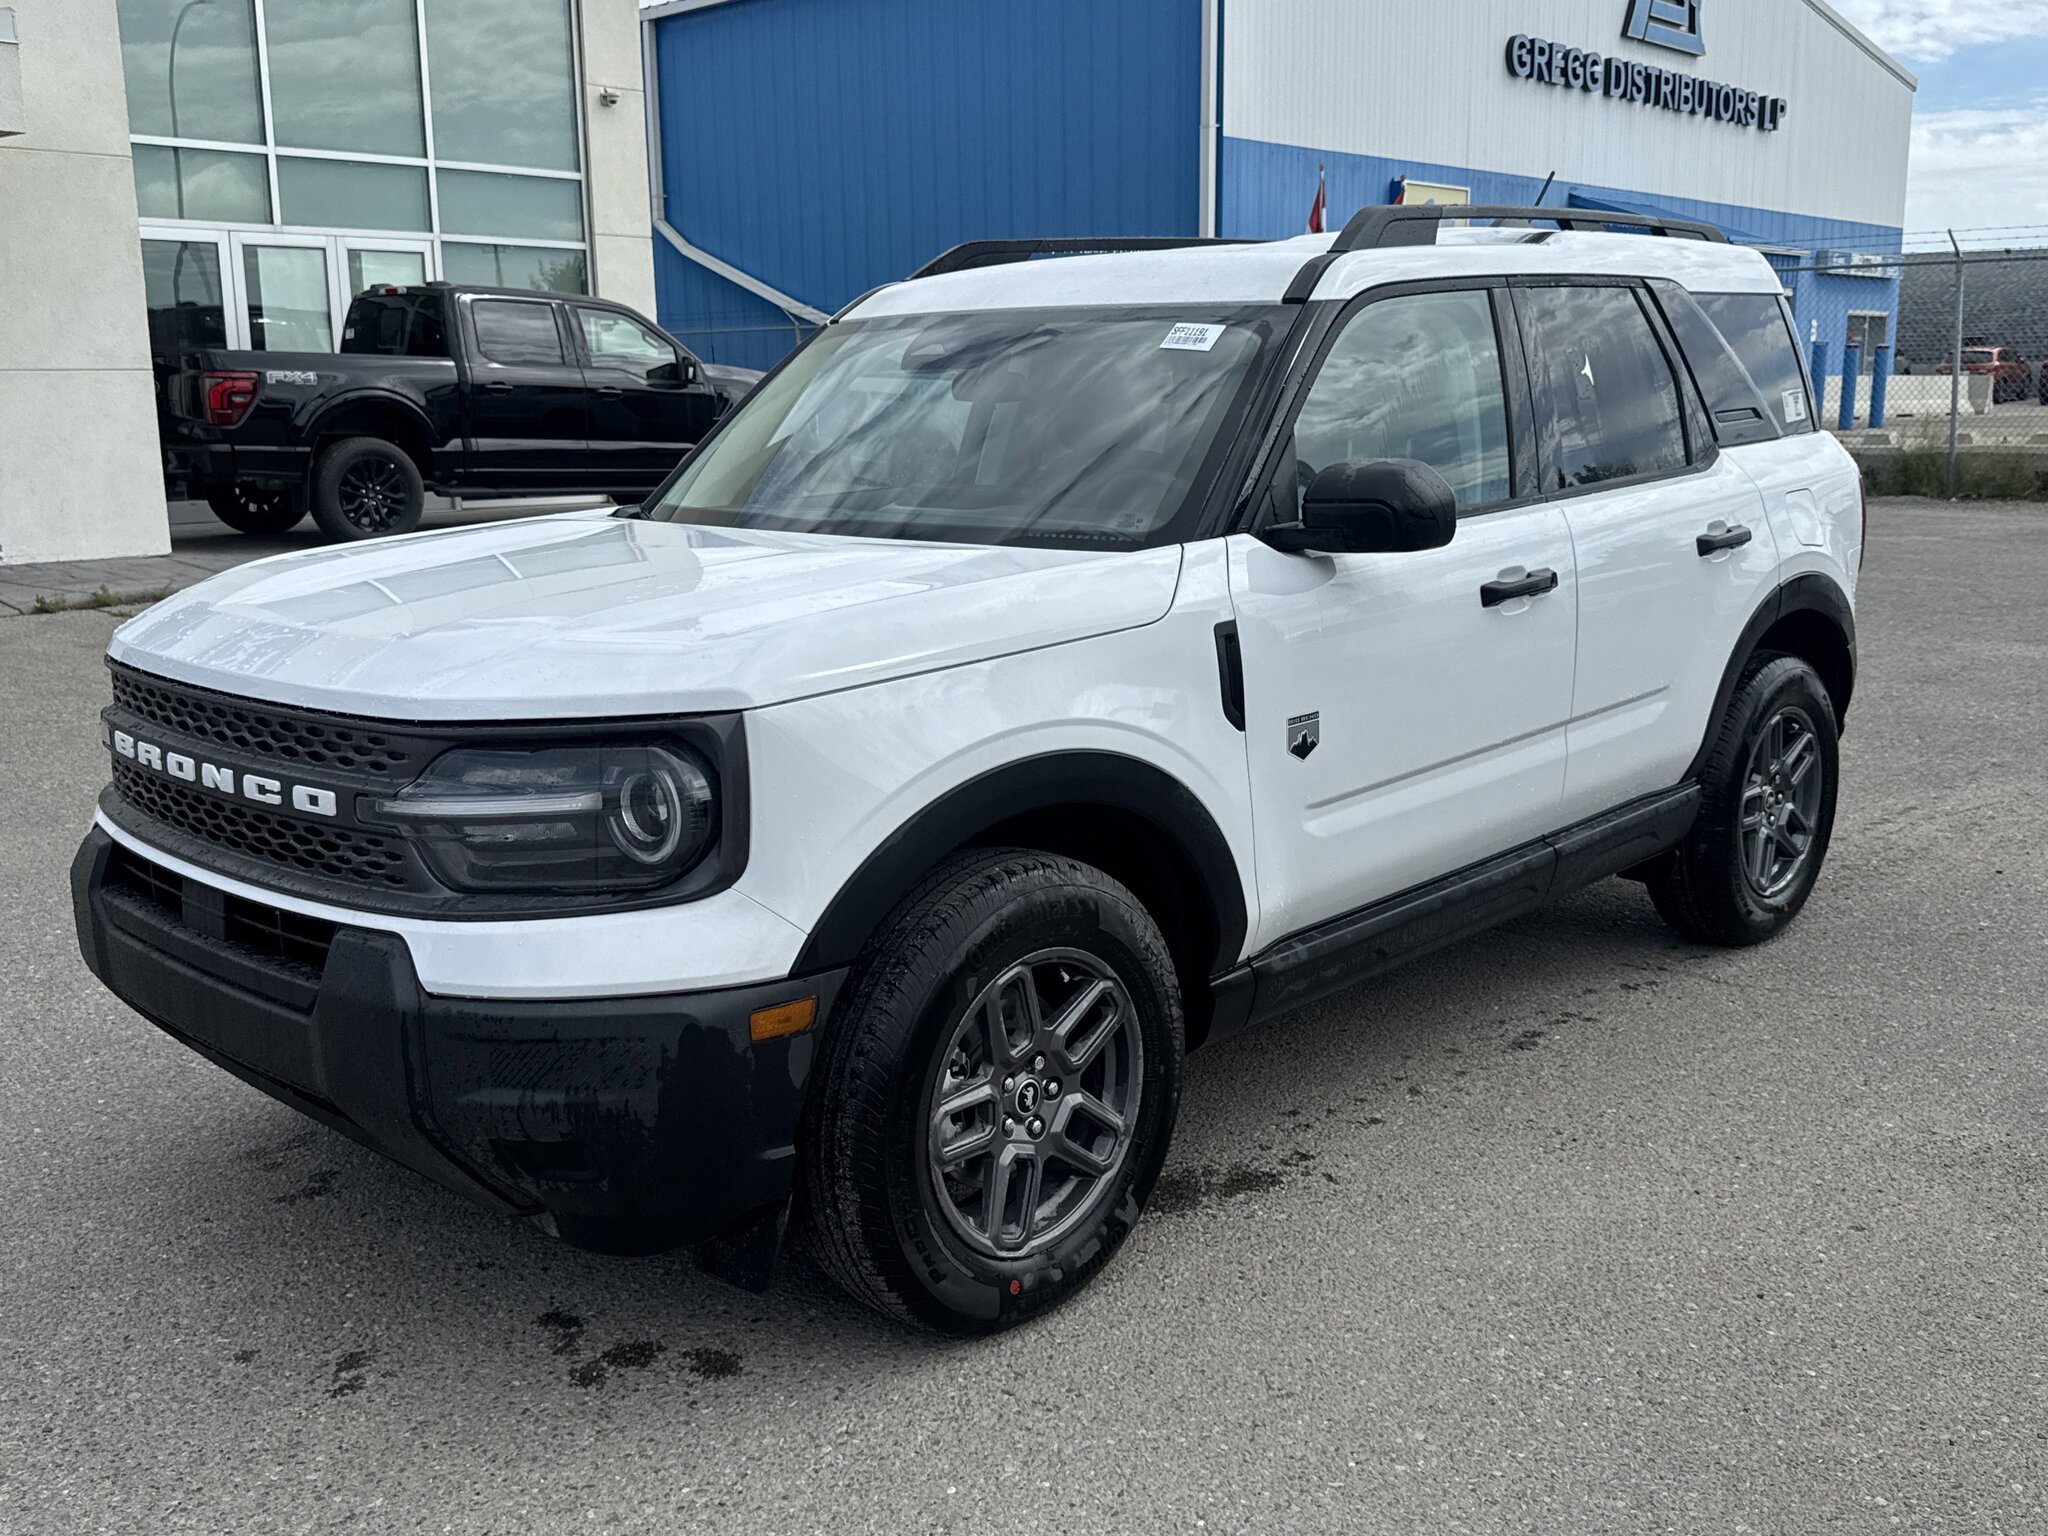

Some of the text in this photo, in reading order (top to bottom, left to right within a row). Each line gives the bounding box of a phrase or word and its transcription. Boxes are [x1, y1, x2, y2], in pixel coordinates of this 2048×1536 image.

[1505, 34, 1787, 131] GREGG DISTRIBUTORS LP
[266, 370, 317, 385] FX4
[114, 730, 337, 817] BRONCO
